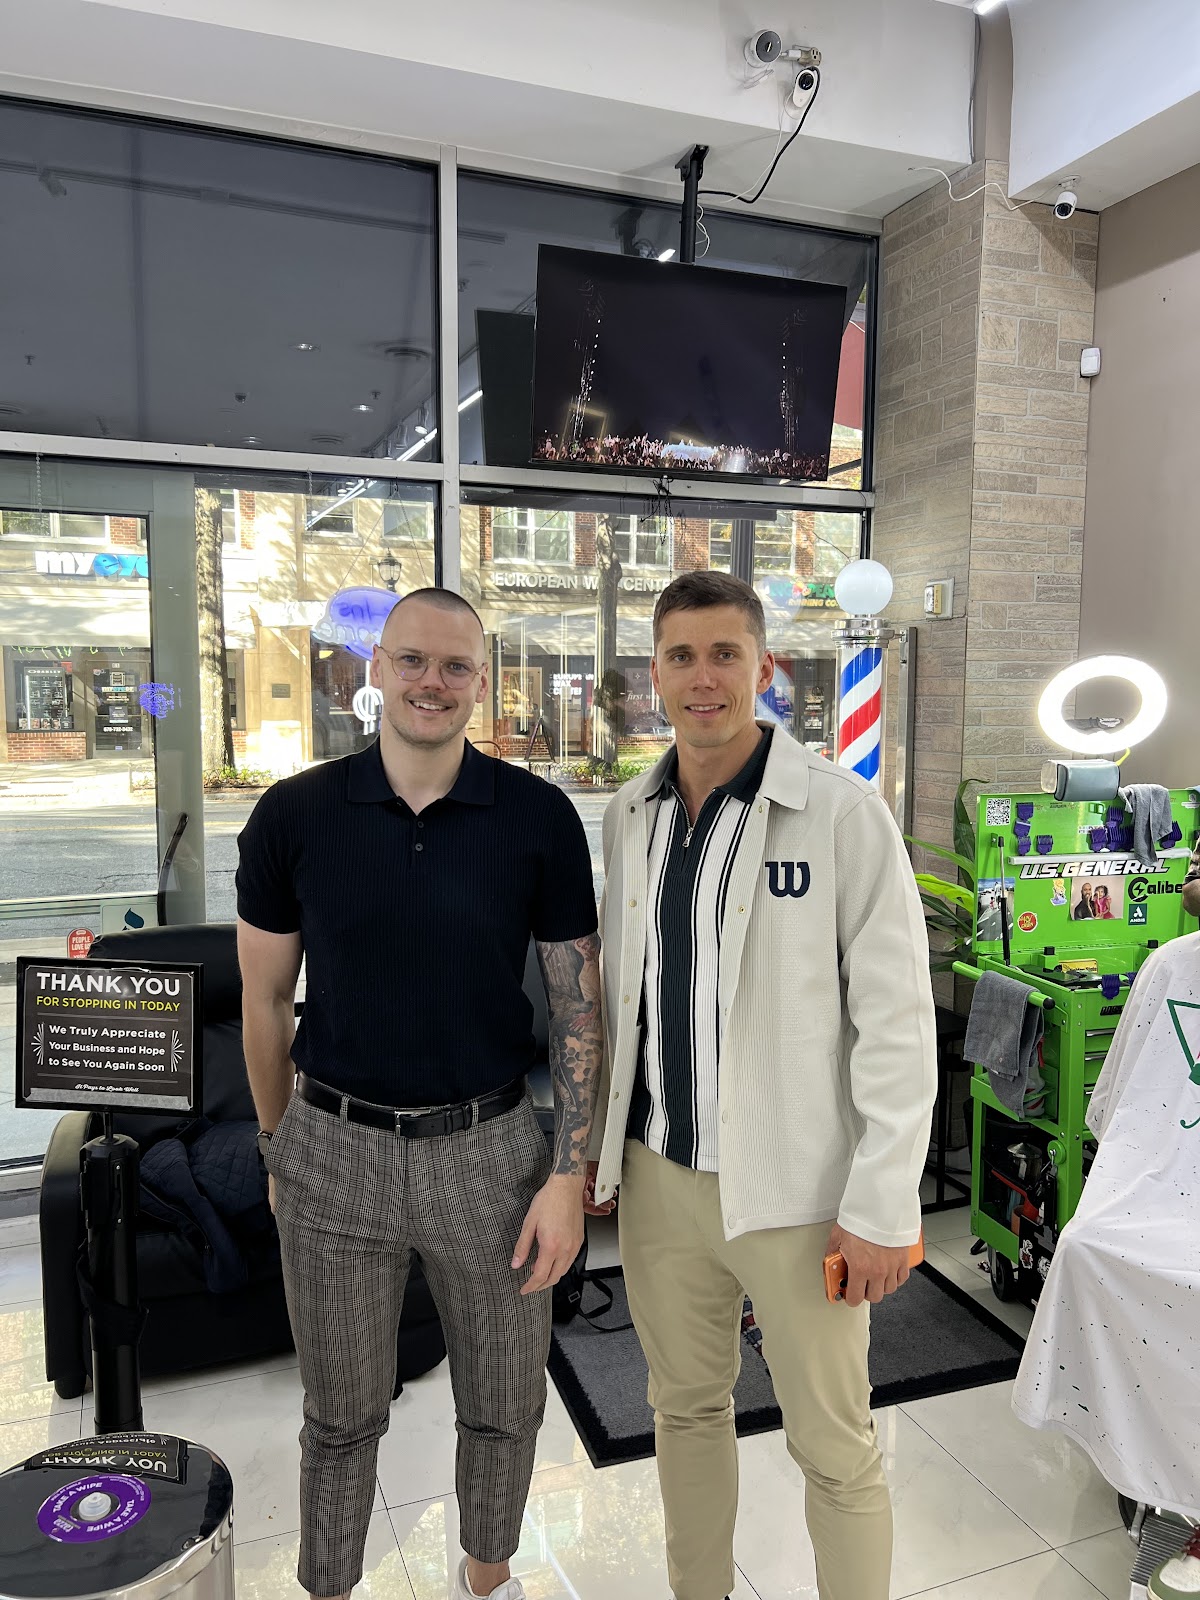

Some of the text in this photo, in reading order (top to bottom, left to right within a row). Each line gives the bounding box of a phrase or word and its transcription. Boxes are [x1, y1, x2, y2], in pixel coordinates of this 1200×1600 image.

[495, 572, 578, 589] EUROPEAN
[623, 576, 673, 592] CENTE
[37, 972, 180, 996] THANK YOU
[36, 996, 181, 1012] FOR STOPPING IN TODAY
[49, 1025, 166, 1039] We Truly Appreciate
[49, 1041, 165, 1056] Your Business and Hope
[49, 1057, 165, 1072] to See You Again Soon
[53, 1494, 70, 1513] TAKE
[76, 1482, 103, 1492] WIPE
[120, 1499, 135, 1517] TAKE
[86, 1521, 114, 1532] WIPE
